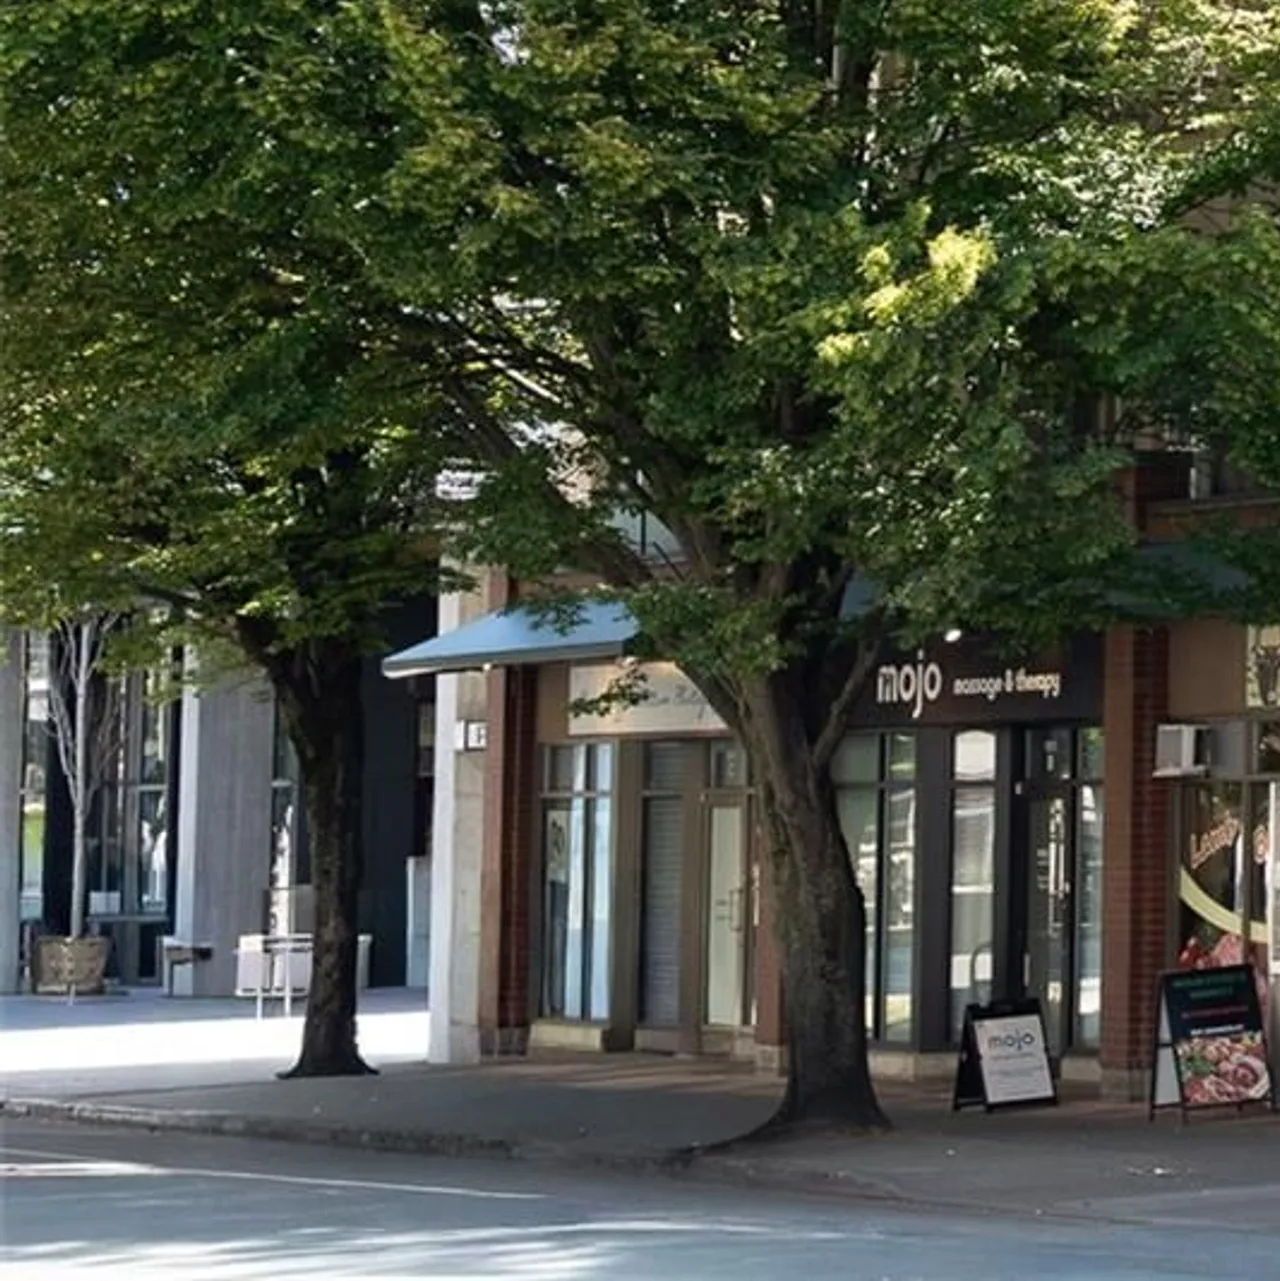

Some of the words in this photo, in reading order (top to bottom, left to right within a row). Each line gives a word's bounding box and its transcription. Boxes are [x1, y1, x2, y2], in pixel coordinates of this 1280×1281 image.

[876, 649, 942, 719] mojo
[953, 677, 1001, 700] massage
[1015, 668, 1061, 699] therapy
[987, 1027, 1035, 1051] mojo
